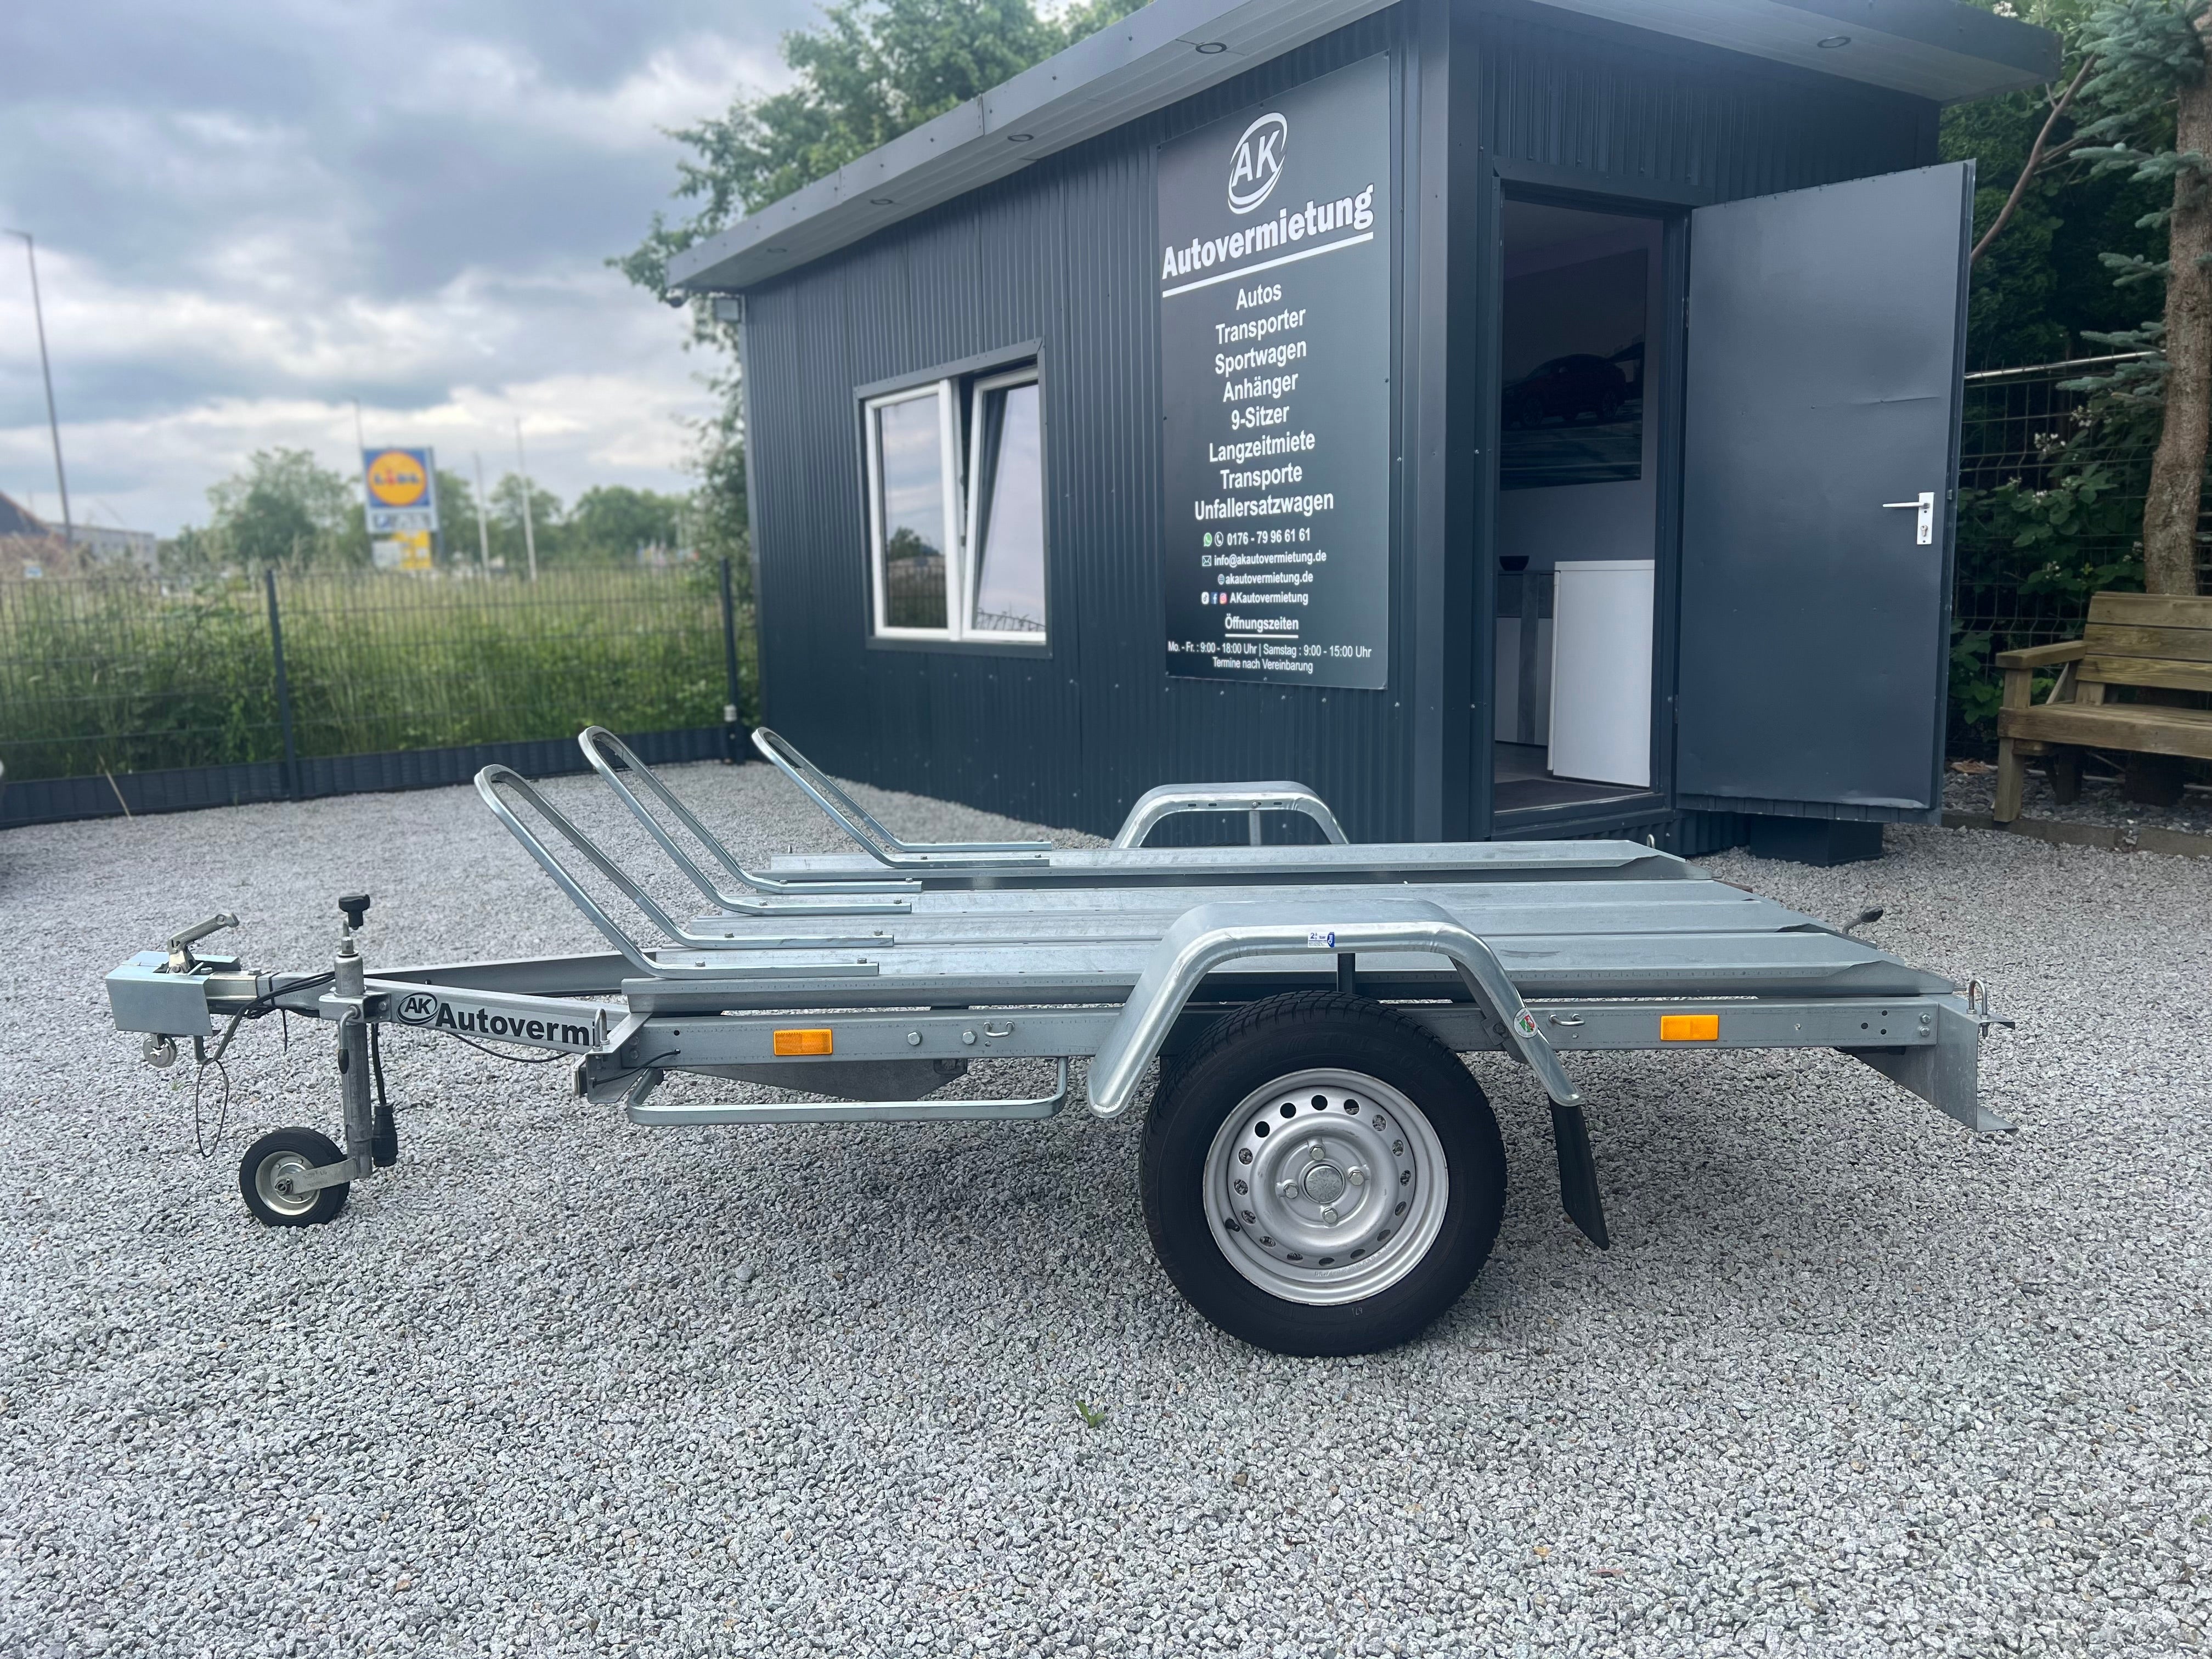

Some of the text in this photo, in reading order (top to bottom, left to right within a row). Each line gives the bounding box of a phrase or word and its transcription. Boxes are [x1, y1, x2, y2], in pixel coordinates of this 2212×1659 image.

[1162, 184, 1374, 280] Autovermietung
[1236, 284, 1282, 311] Autos
[1216, 308, 1306, 345] Transporter
[1215, 340, 1307, 377] Sportwagen
[1223, 373, 1299, 403] Anhänger
[1231, 405, 1289, 430] 9-Sitzer
[1209, 430, 1316, 464] Langzeitmiete
[1220, 462, 1302, 490] Transporte
[1195, 493, 1334, 521] Unfallersatzwagen
[1227, 532, 1249, 546] 0176
[1256, 531, 1268, 544] 79
[1270, 529, 1282, 543] 96
[1284, 528, 1295, 543] 61
[1299, 527, 1310, 541] 61
[1214, 550, 1327, 568] info@akautovermietung.de
[1226, 571, 1313, 585] akautovermietung.de
[1229, 591, 1308, 606] AKautovermietung
[1224, 613, 1299, 633] Öffnungszeiten
[1168, 641, 1180, 652] Mo.
[1200, 642, 1216, 652] 9:00
[1222, 643, 1242, 653] 18:00
[1244, 644, 1257, 654] Uhr
[1263, 644, 1297, 658] Samstag
[1304, 645, 1322, 656] 9:00
[1329, 645, 1353, 657] 15:00
[1356, 646, 1372, 657] Uhr
[1212, 656, 1314, 674] Termine nach Vereinbarung
[404, 997, 612, 1047] AK Autoverm
